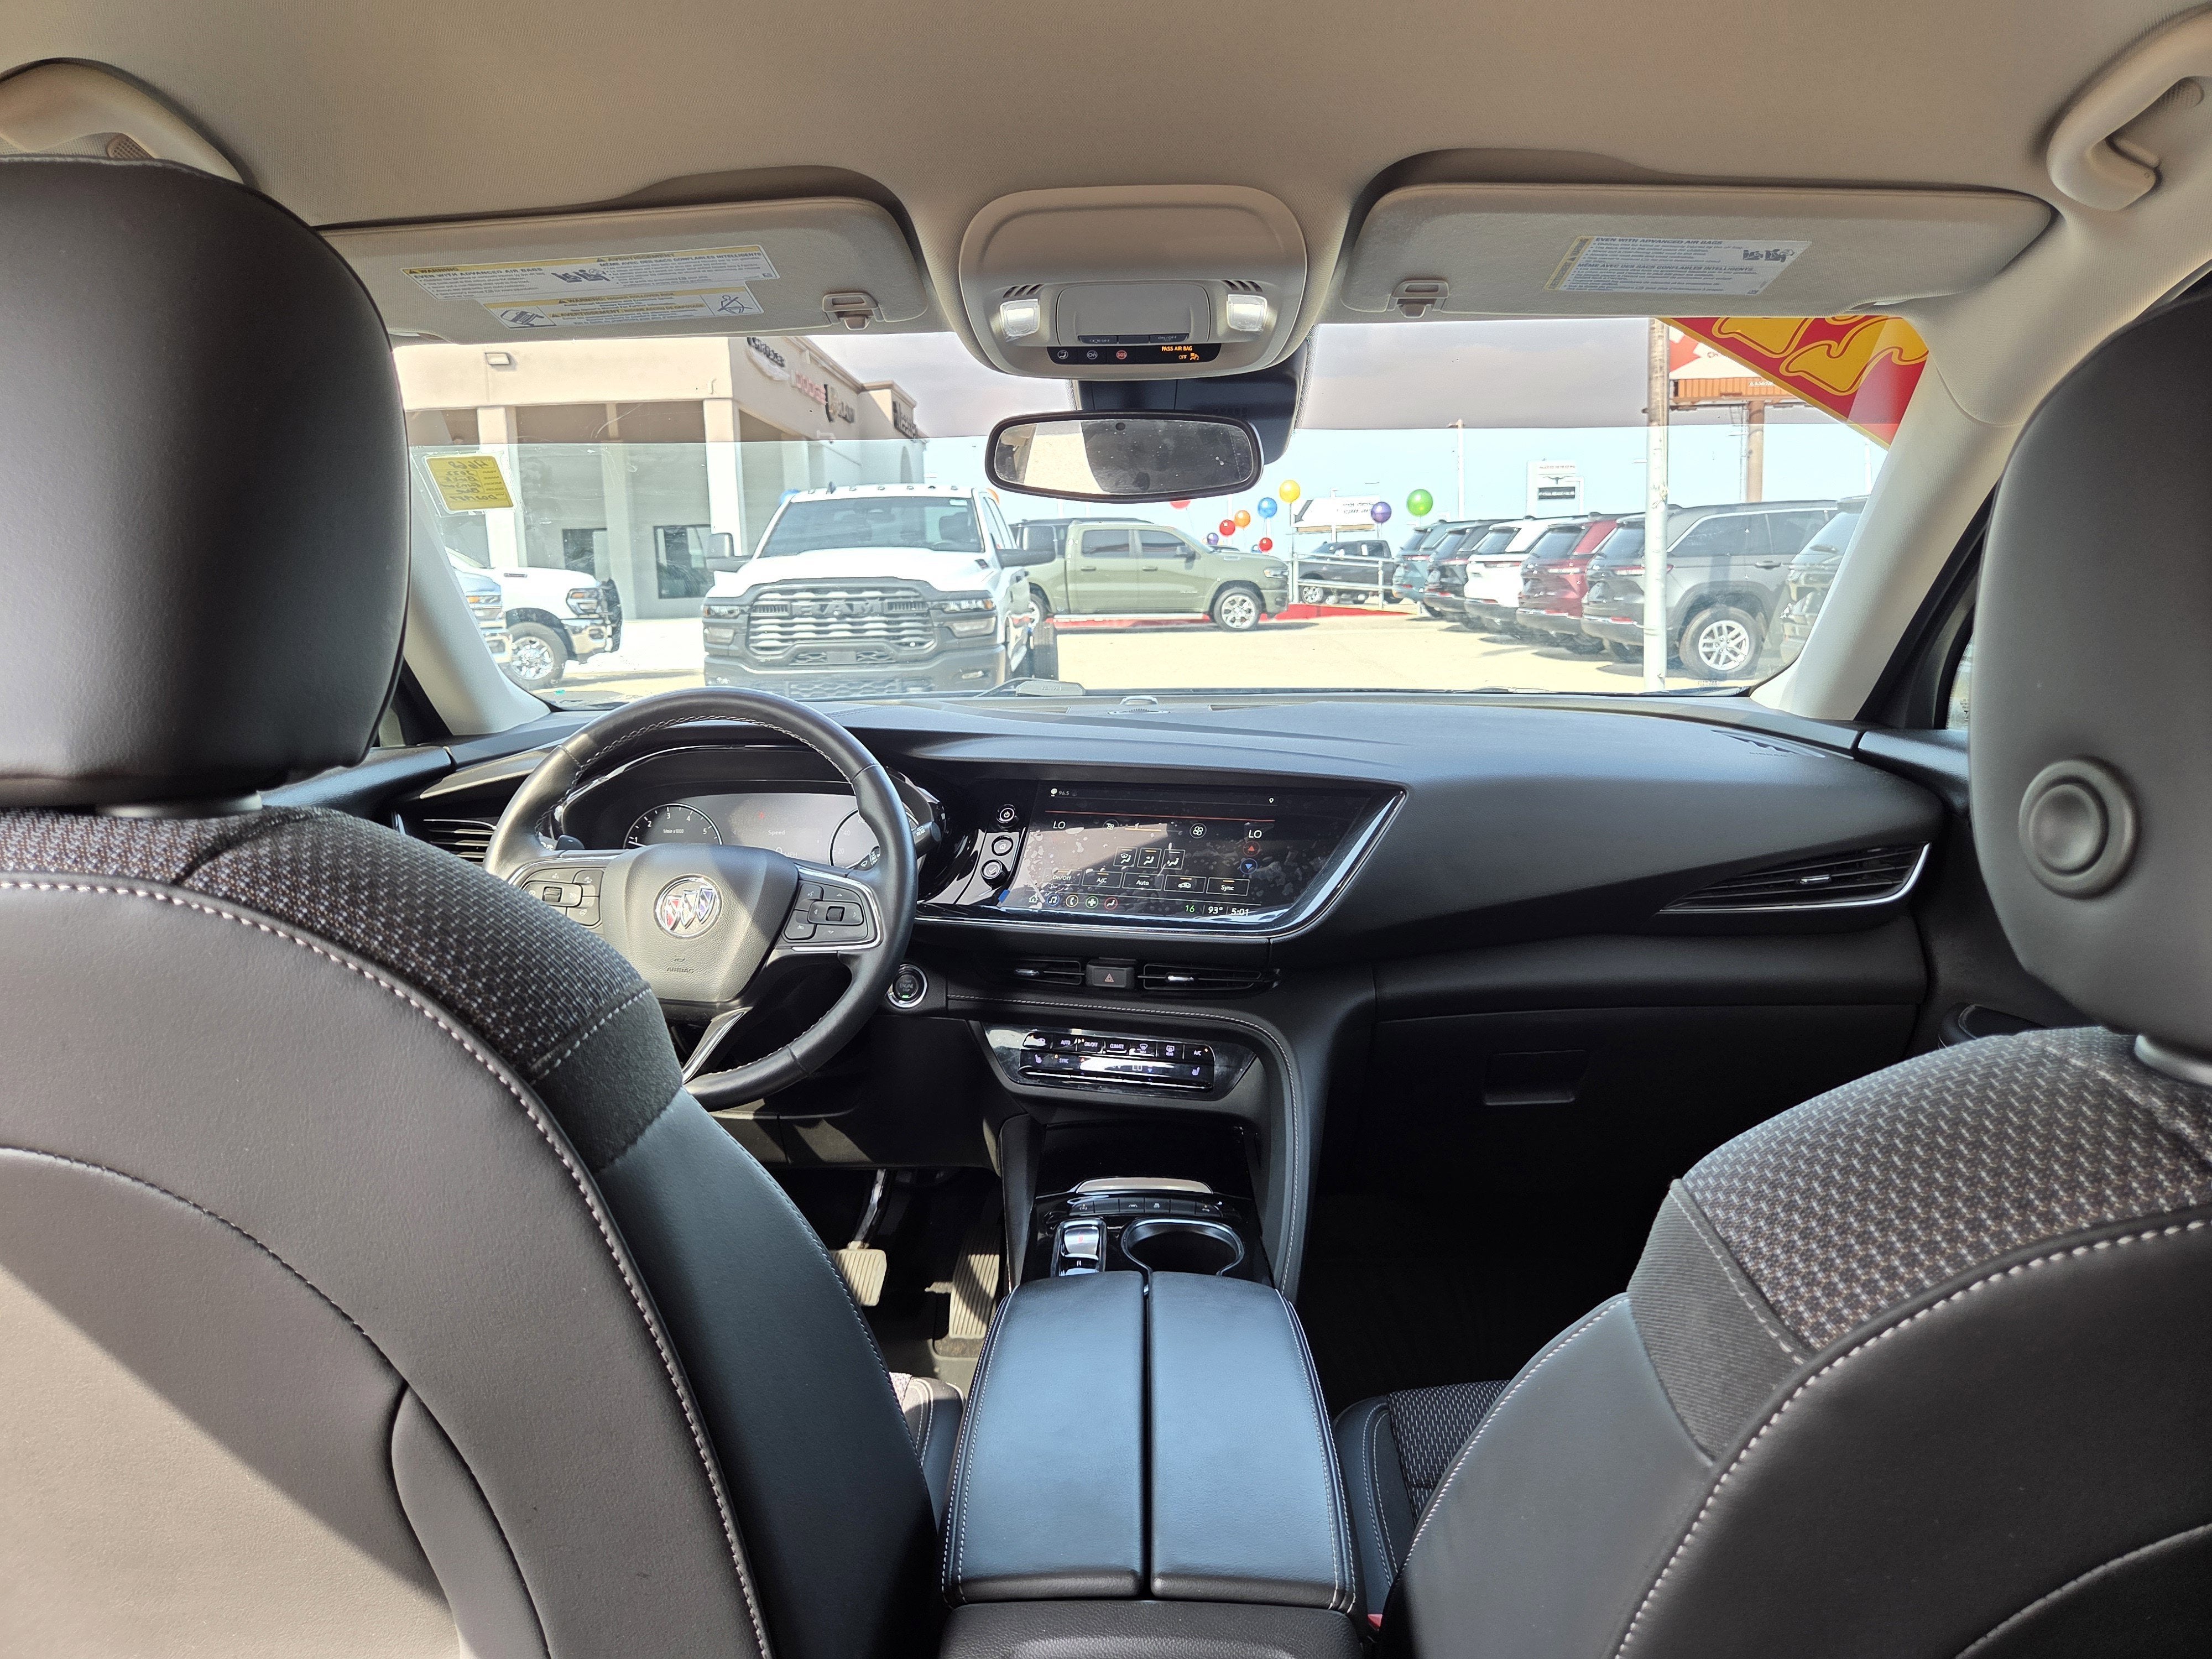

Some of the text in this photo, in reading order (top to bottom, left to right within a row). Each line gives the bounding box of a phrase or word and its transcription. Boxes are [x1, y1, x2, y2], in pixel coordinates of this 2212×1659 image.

[791, 599, 883, 615] RAM
[1053, 820, 1066, 830] LO
[1248, 830, 1262, 839] LO
[1231, 907, 1250, 916] 5:01
